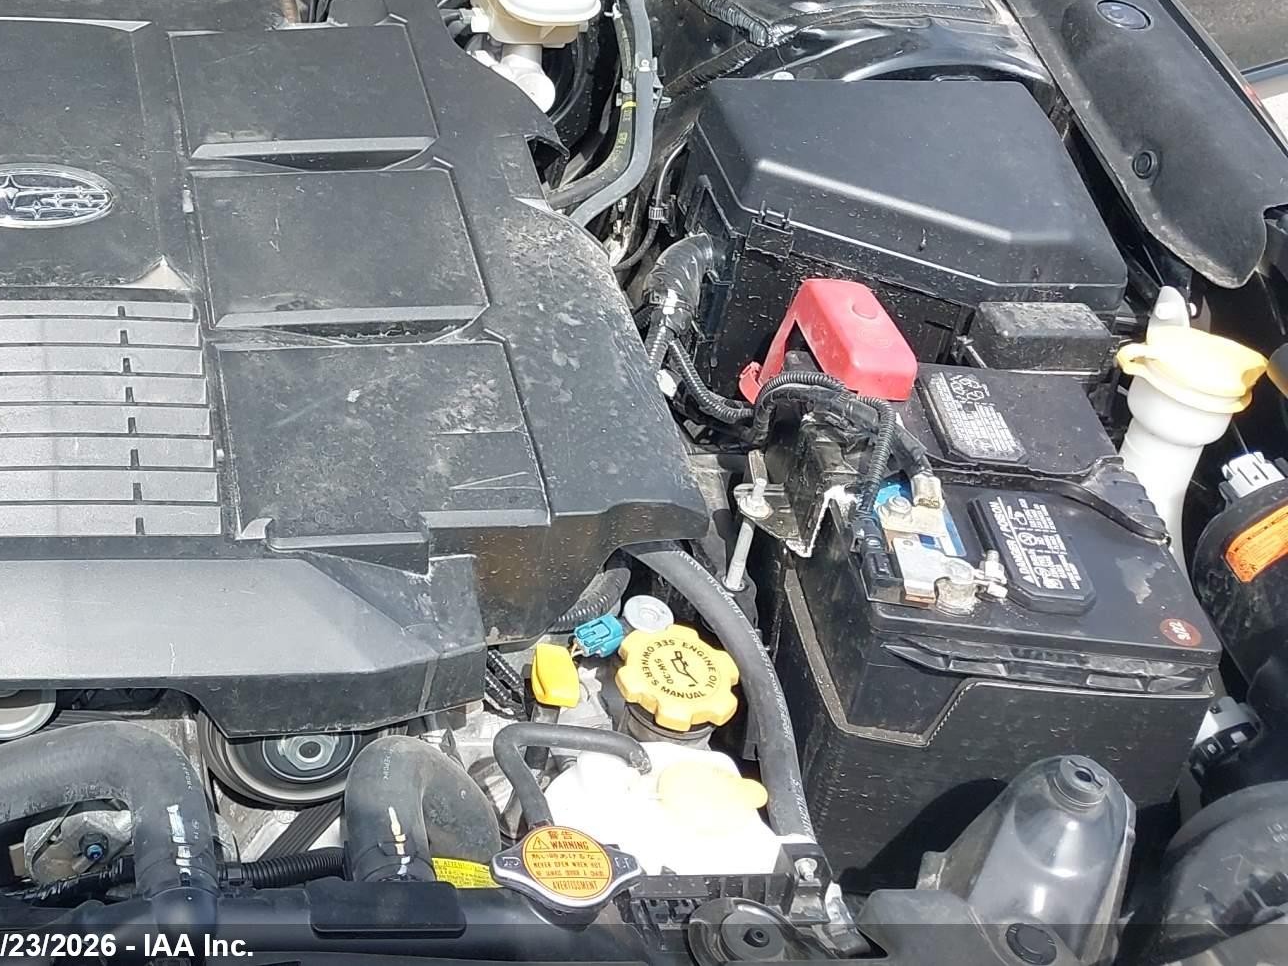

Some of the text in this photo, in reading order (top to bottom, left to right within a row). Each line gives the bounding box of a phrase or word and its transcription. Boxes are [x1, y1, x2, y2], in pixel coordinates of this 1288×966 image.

[656, 639, 676, 649] SEE
[654, 658, 674, 685] 5W-30
[682, 642, 718, 689] ENGINE OIL
[660, 686, 707, 700] MANUAL
[550, 840, 589, 850] WARNING
